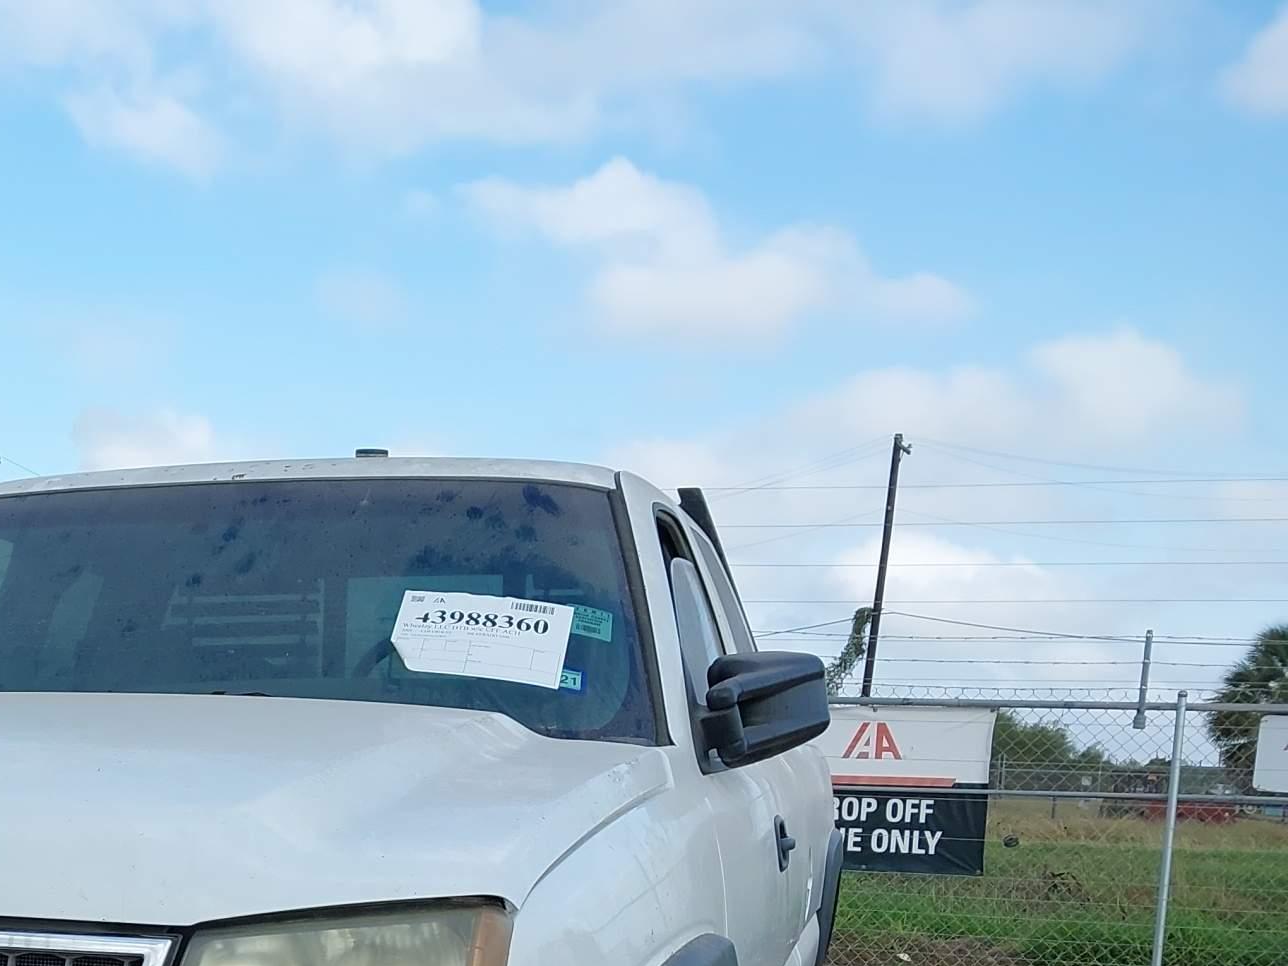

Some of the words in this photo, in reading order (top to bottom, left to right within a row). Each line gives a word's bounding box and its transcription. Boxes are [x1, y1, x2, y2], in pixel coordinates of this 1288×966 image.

[415, 609, 549, 635] 43988360
[832, 796, 878, 822] ROP
[885, 798, 935, 824] OFF
[870, 828, 943, 855] ONLY
